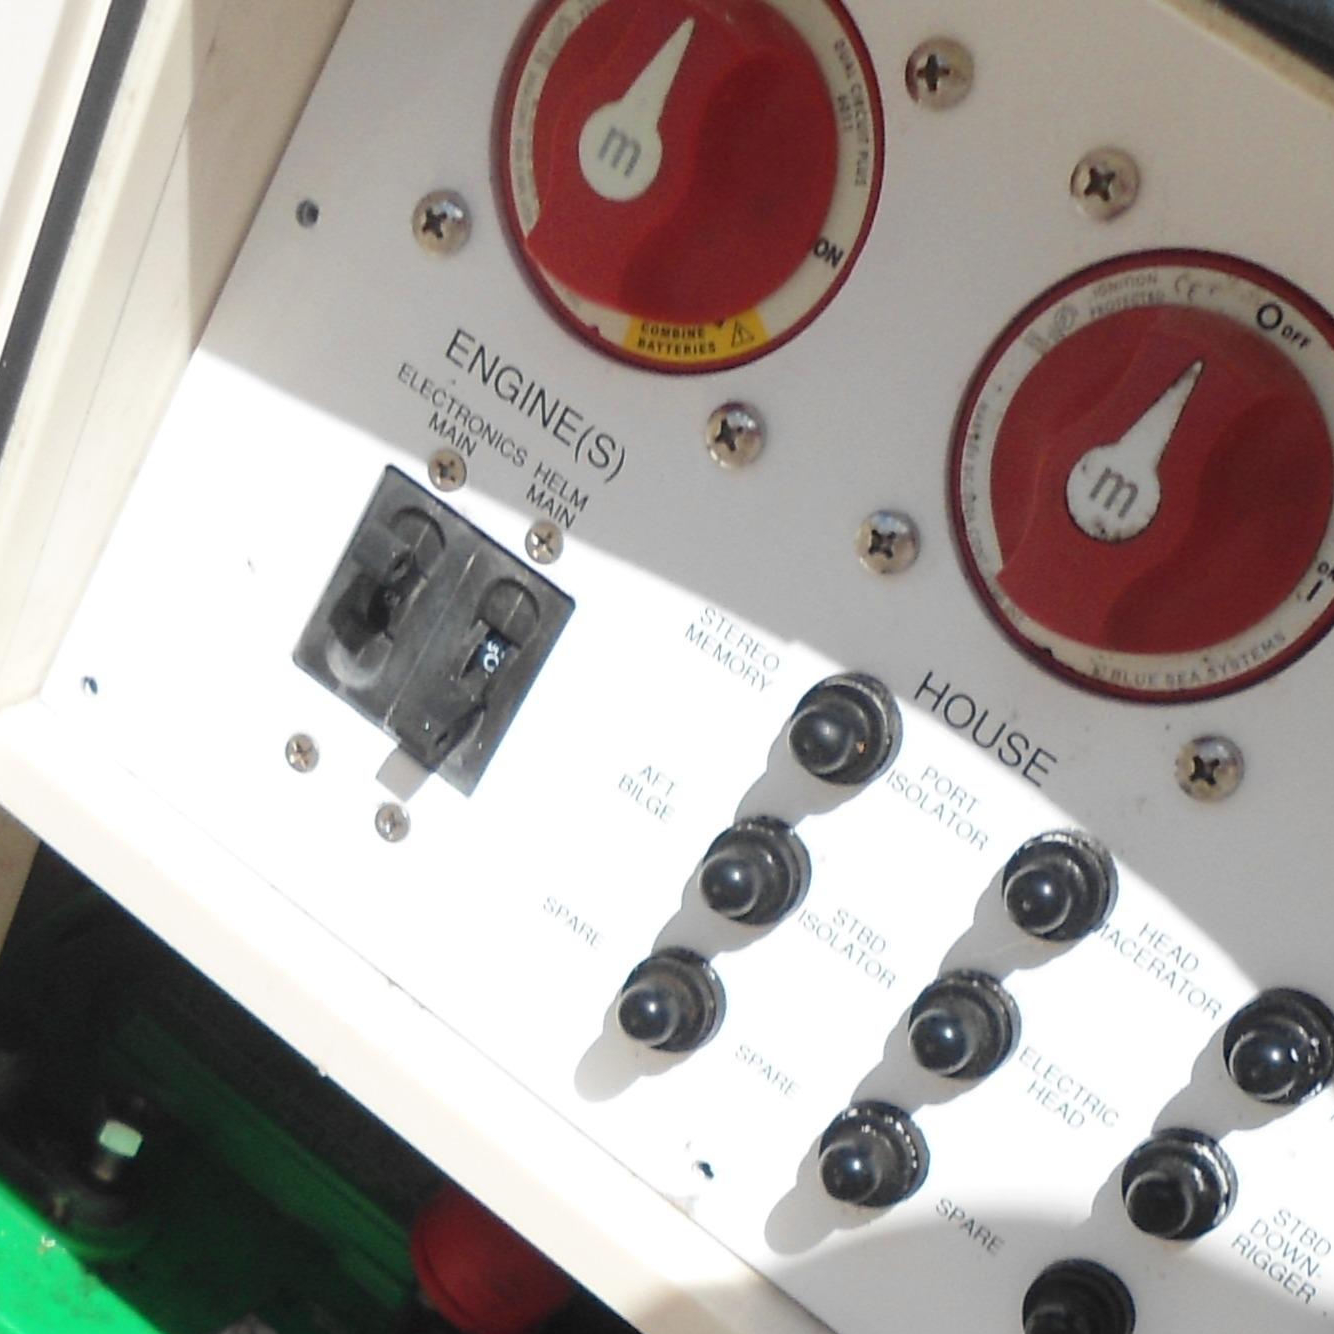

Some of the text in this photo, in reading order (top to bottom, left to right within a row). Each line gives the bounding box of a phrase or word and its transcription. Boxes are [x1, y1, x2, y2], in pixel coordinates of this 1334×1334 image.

[812, 237, 844, 269] ON
[637, 336, 717, 357] BATTERIES
[640, 322, 706, 341] COMBINE
[1281, 325, 1312, 350] OFF
[397, 362, 528, 467] ELECTRONICS
[445, 328, 626, 482] ENGINE(S)
[428, 413, 477, 457] MAIN
[526, 488, 577, 529] MAIN
[533, 462, 589, 512] HELM
[685, 623, 771, 692] MEMORY
[699, 607, 780, 673] STEREO
[1165, 670, 1201, 686] SEA
[914, 671, 1058, 788] HOUSE
[618, 773, 675, 823] BILGE
[639, 764, 678, 796] AFT
[921, 766, 980, 814] PORT
[886, 769, 989, 851] ISOLATOR
[543, 896, 606, 950] SPARE
[831, 908, 887, 955] STBD
[1138, 922, 1199, 973] HEAD
[797, 908, 897, 990] ISOLATOR
[734, 1043, 801, 1099] SPARE
[1019, 1046, 1120, 1128] ELECTRIC
[1027, 1079, 1085, 1130] HEAD
[935, 1198, 1005, 1255] SPARE
[1250, 1218, 1323, 1281] DOWN-
[1272, 1208, 1332, 1257] STBD
[1230, 1234, 1317, 1304] RIGGER
